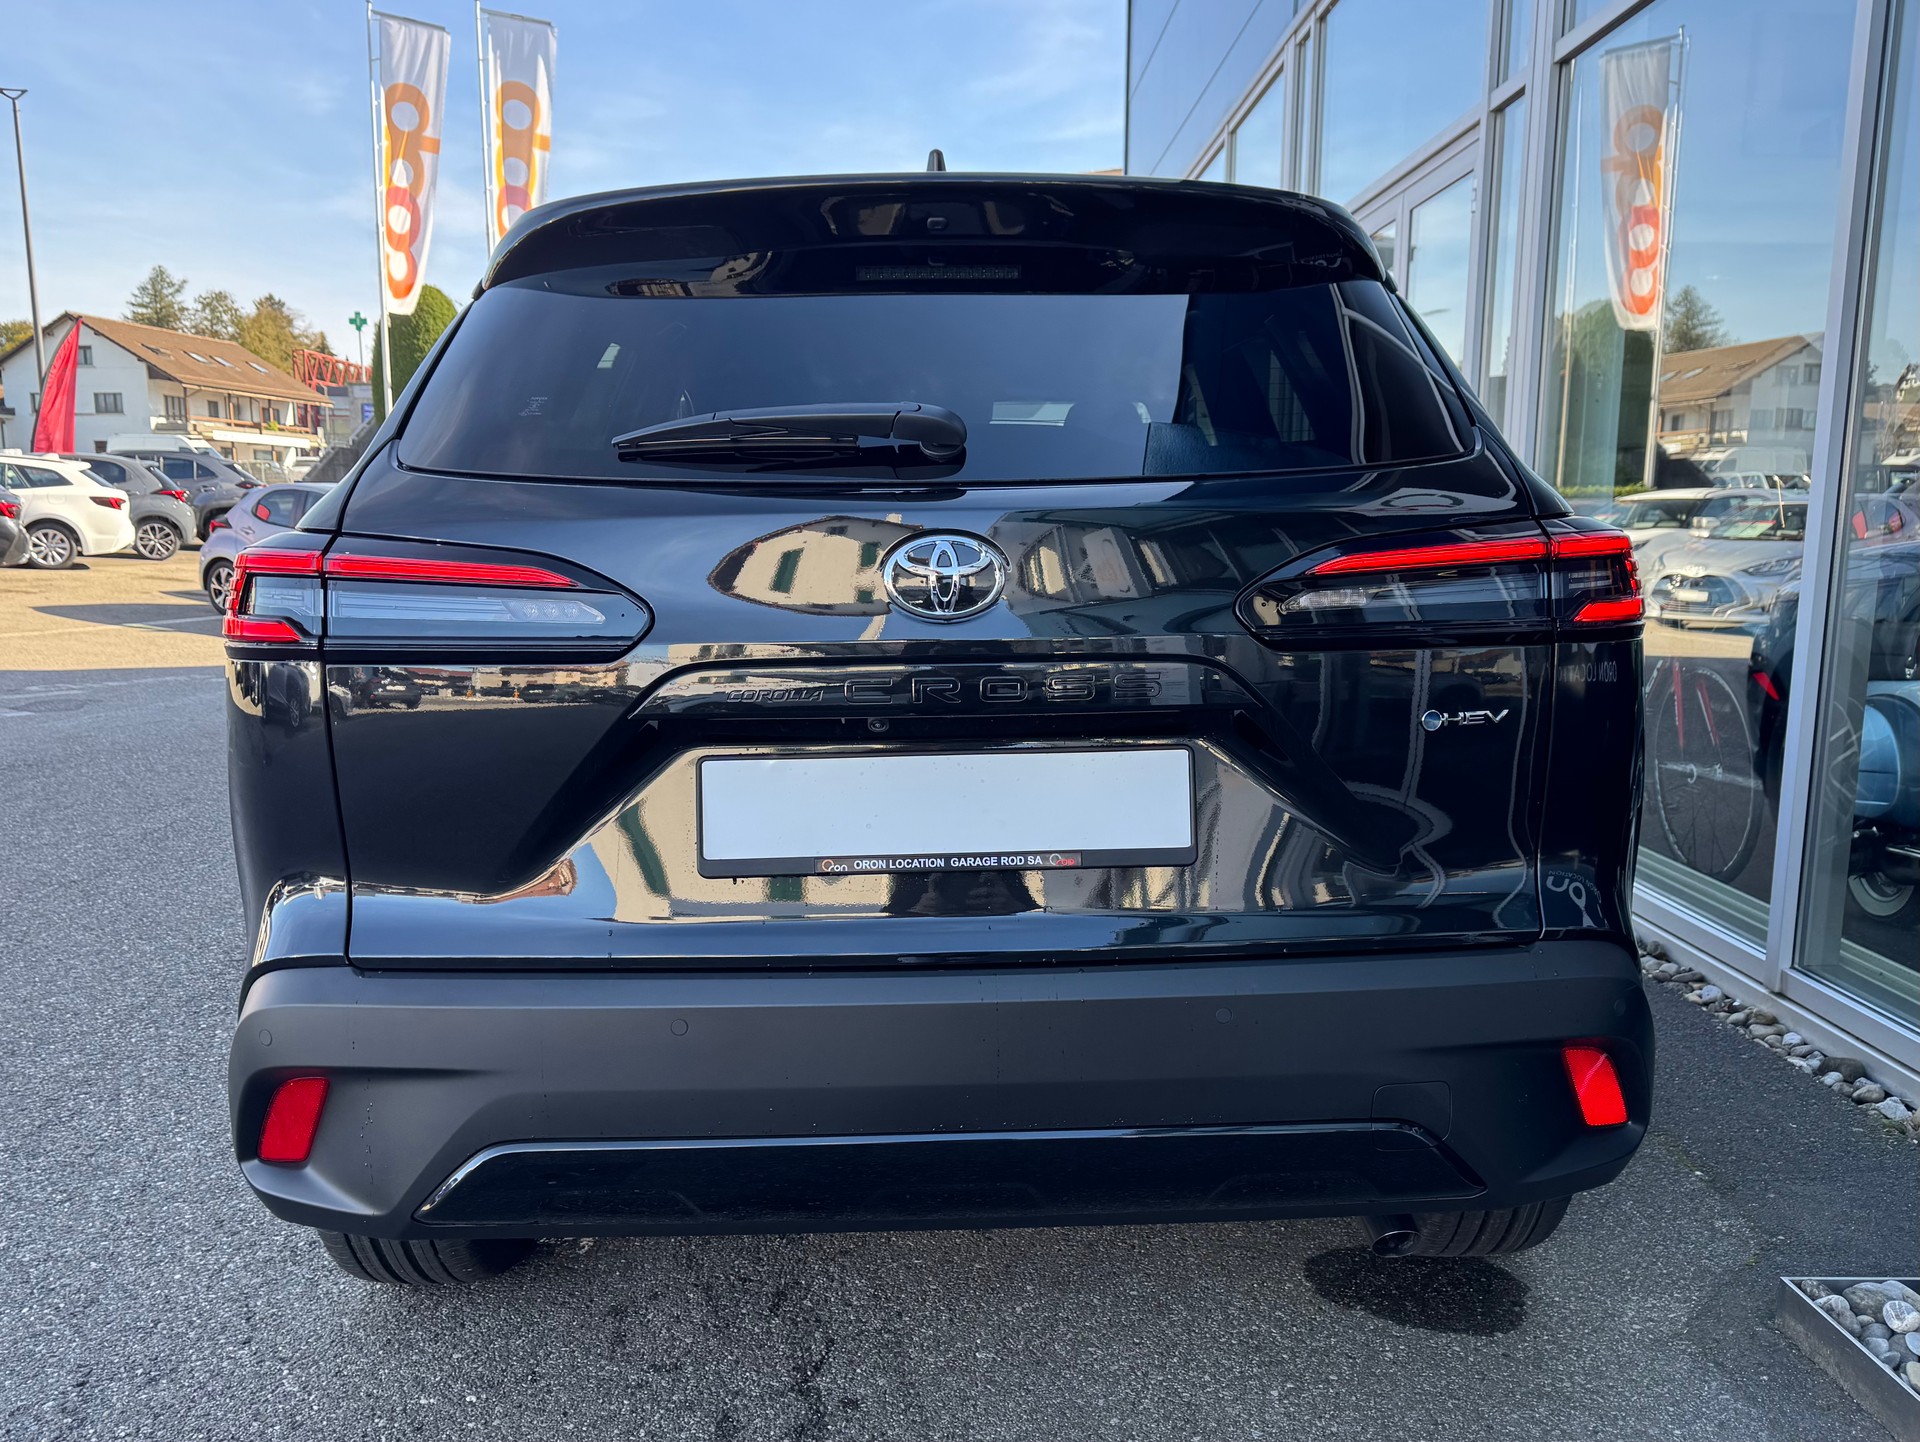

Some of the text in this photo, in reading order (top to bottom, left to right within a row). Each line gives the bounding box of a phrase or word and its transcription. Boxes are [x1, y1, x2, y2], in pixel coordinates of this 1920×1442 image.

[495, 80, 550, 242] oop
[726, 672, 1163, 705] COROLLA CROSS
[1442, 708, 1509, 726] HEV
[853, 859, 887, 870] ORON
[889, 857, 945, 869] LOCATION
[950, 856, 999, 867] GARAGE
[1000, 855, 1025, 866] ROD
[1027, 854, 1043, 865] SA
